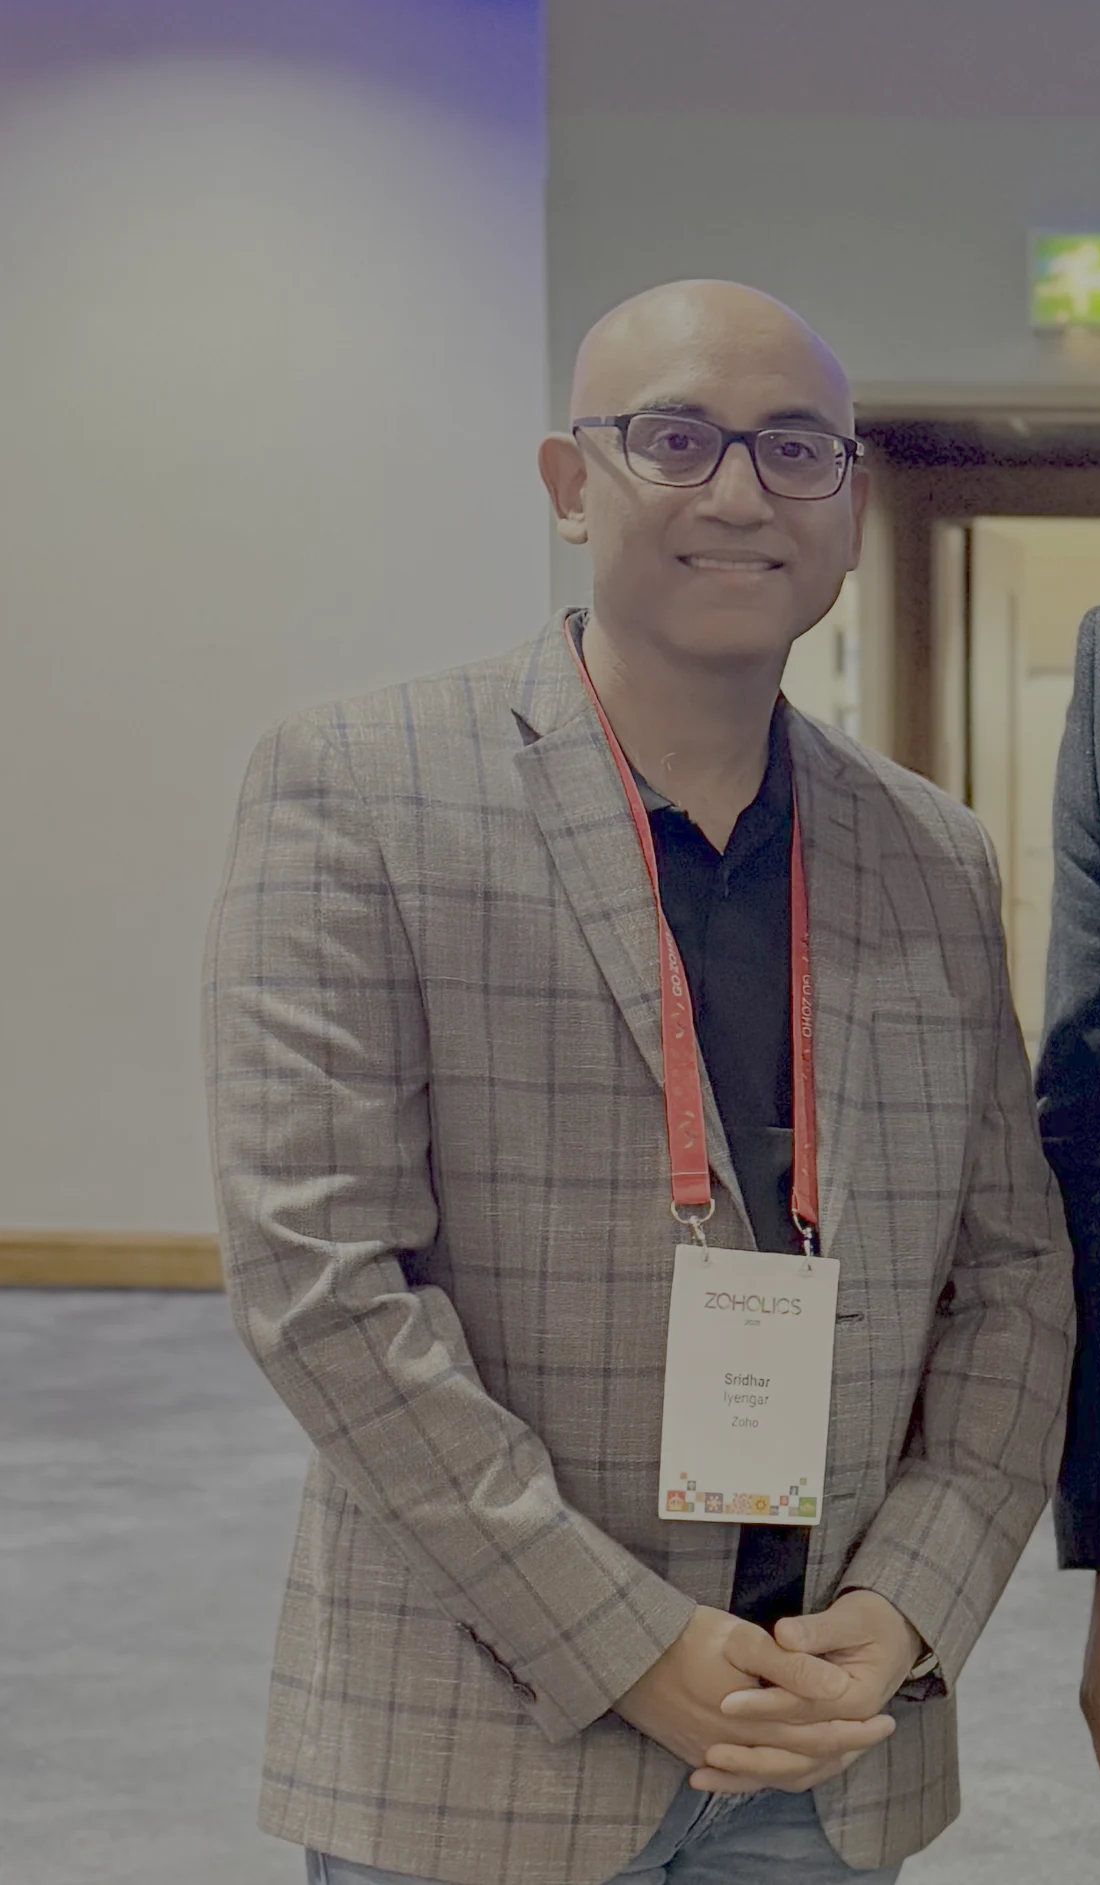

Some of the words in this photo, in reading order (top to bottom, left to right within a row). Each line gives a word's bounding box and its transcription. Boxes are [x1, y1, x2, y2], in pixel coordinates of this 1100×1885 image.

[671, 974, 683, 997] GO
[801, 997, 813, 1038] ZOHO
[704, 1292, 802, 1316] ZOHOLICS
[724, 1372, 771, 1389] Sridhar
[723, 1391, 769, 1408] Iyengar
[731, 1415, 760, 1429] Zoho
